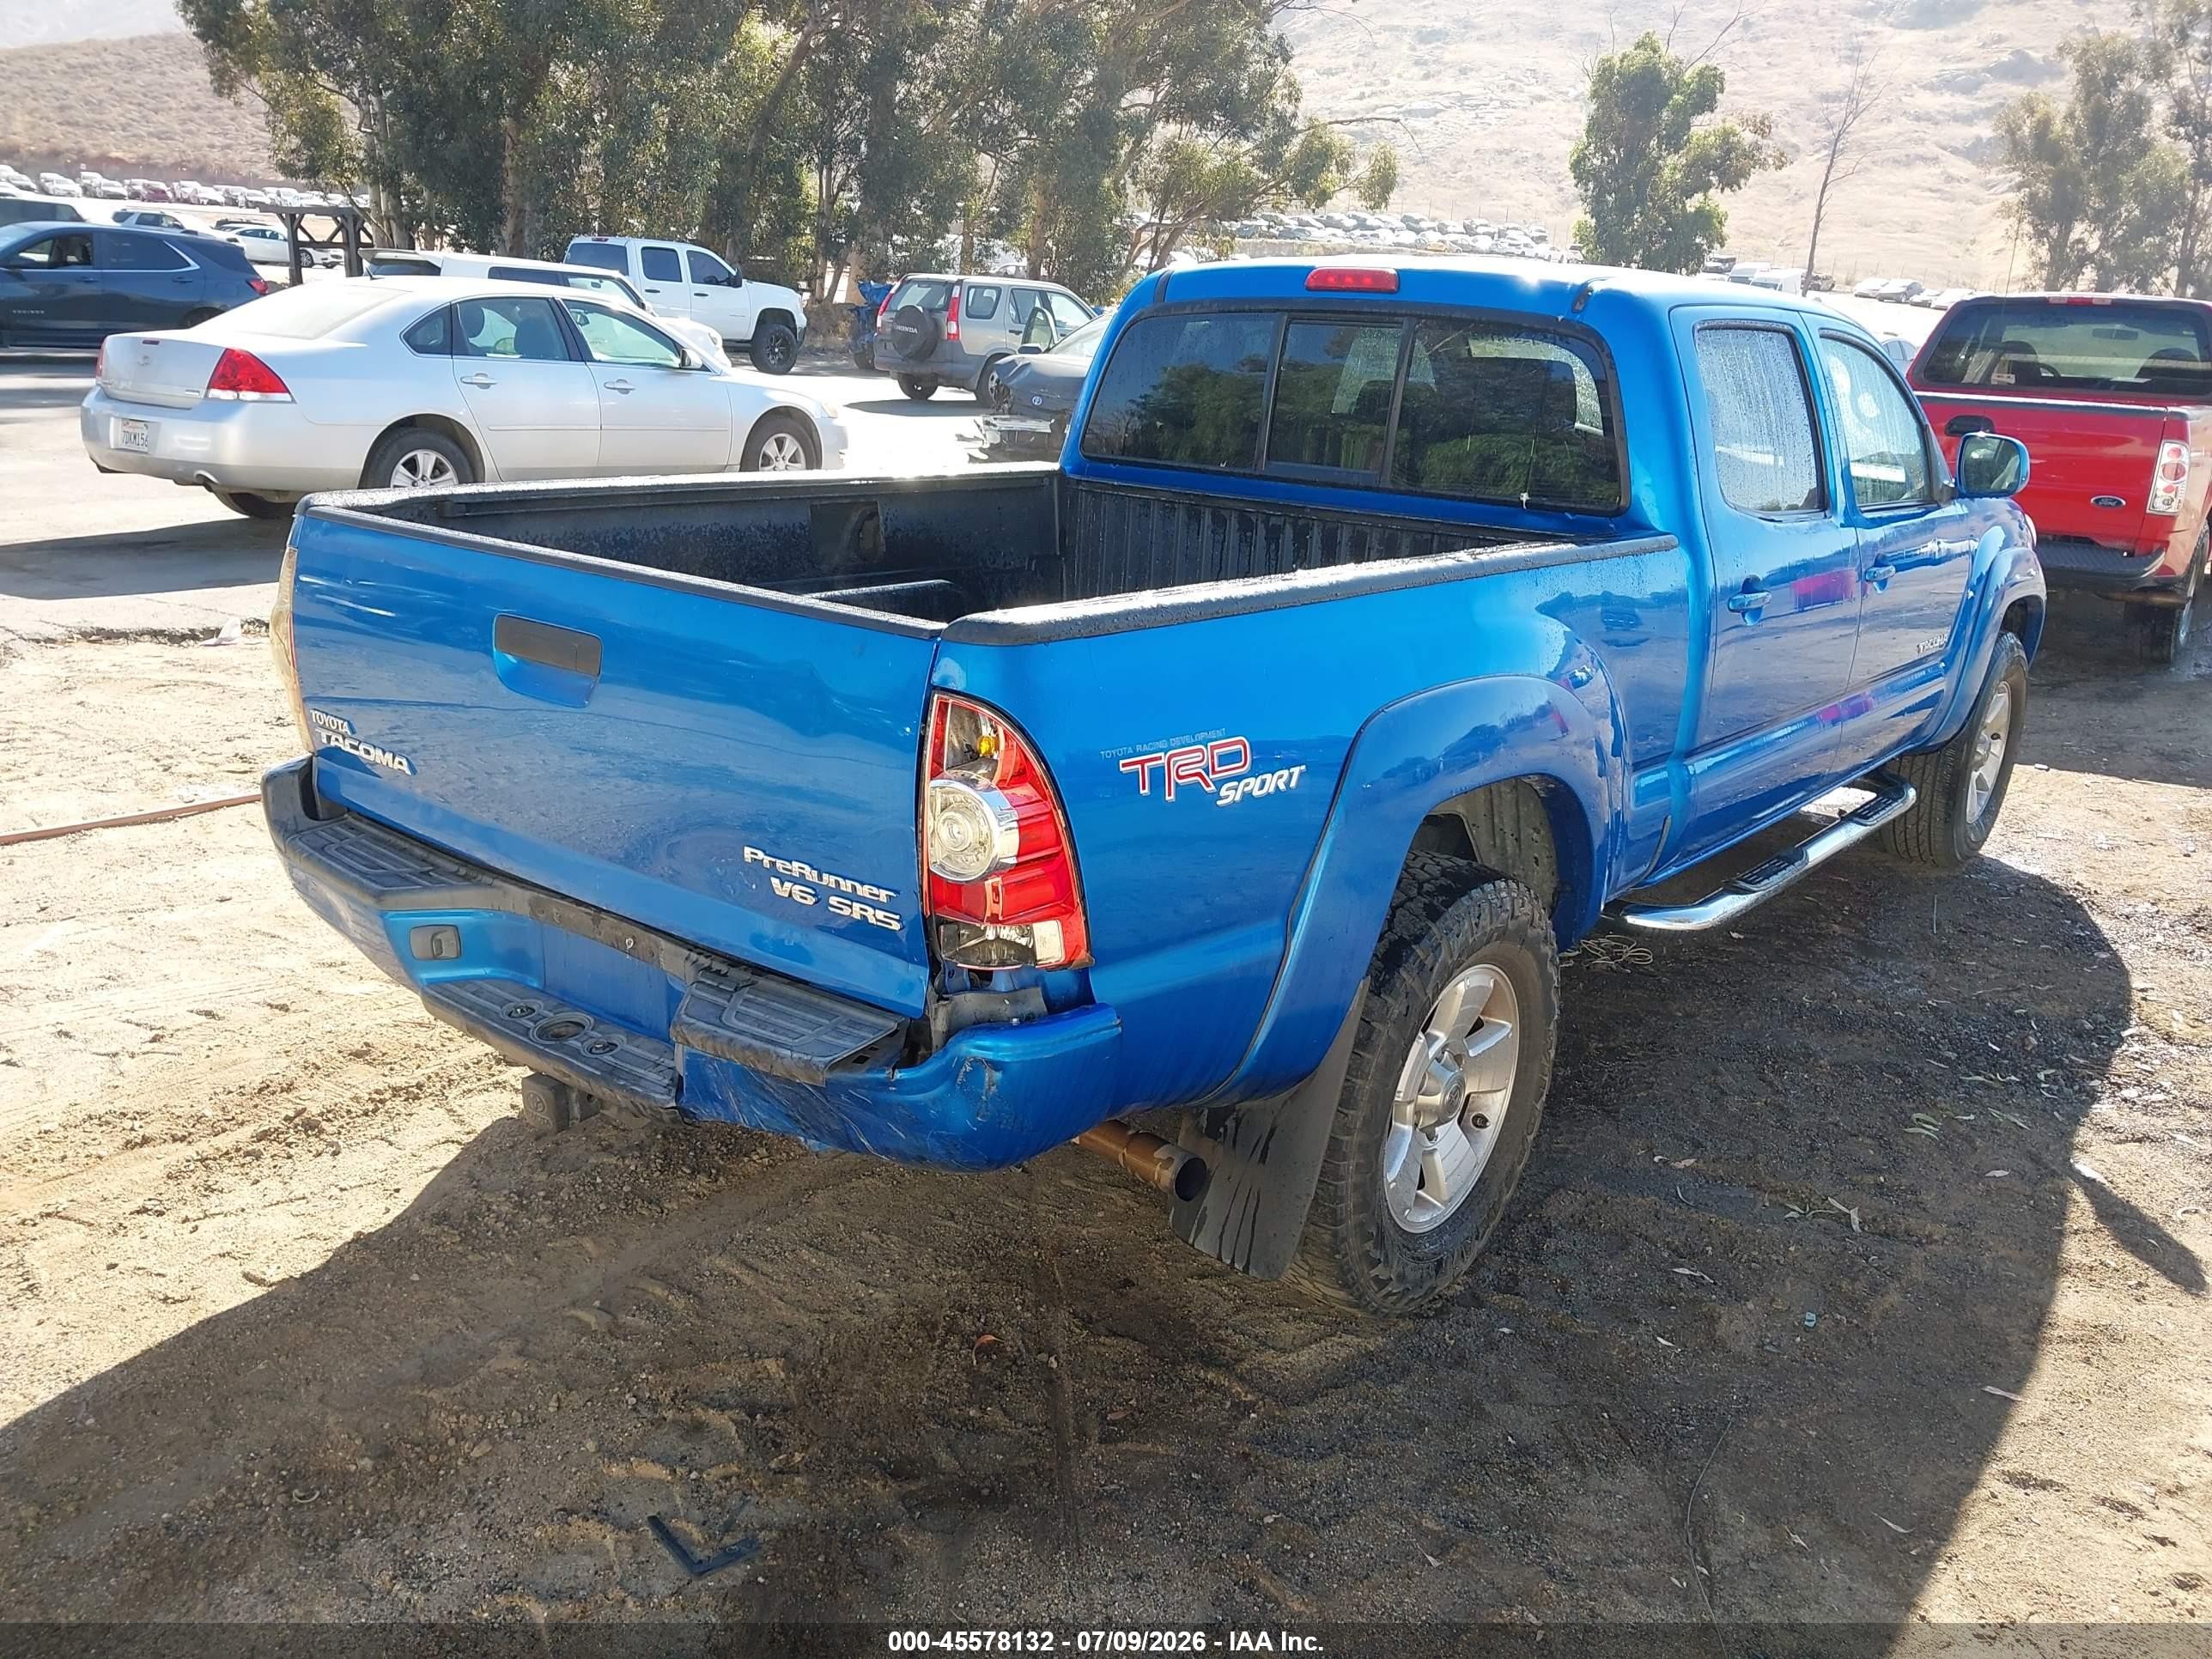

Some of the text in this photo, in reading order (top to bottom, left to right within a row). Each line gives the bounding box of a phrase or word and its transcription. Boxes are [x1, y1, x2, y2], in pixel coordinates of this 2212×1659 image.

[895, 324, 918, 334] HONDA
[309, 708, 353, 736] TOYOTA
[1100, 728, 1226, 760] TOYOTA RACING DEVELOPMENT
[314, 726, 413, 776] TACOMA
[1119, 736, 1251, 803] TRD
[1216, 765, 1306, 806] SPORT
[743, 845, 900, 902] PreRunner
[770, 877, 904, 932] V6 SR5
